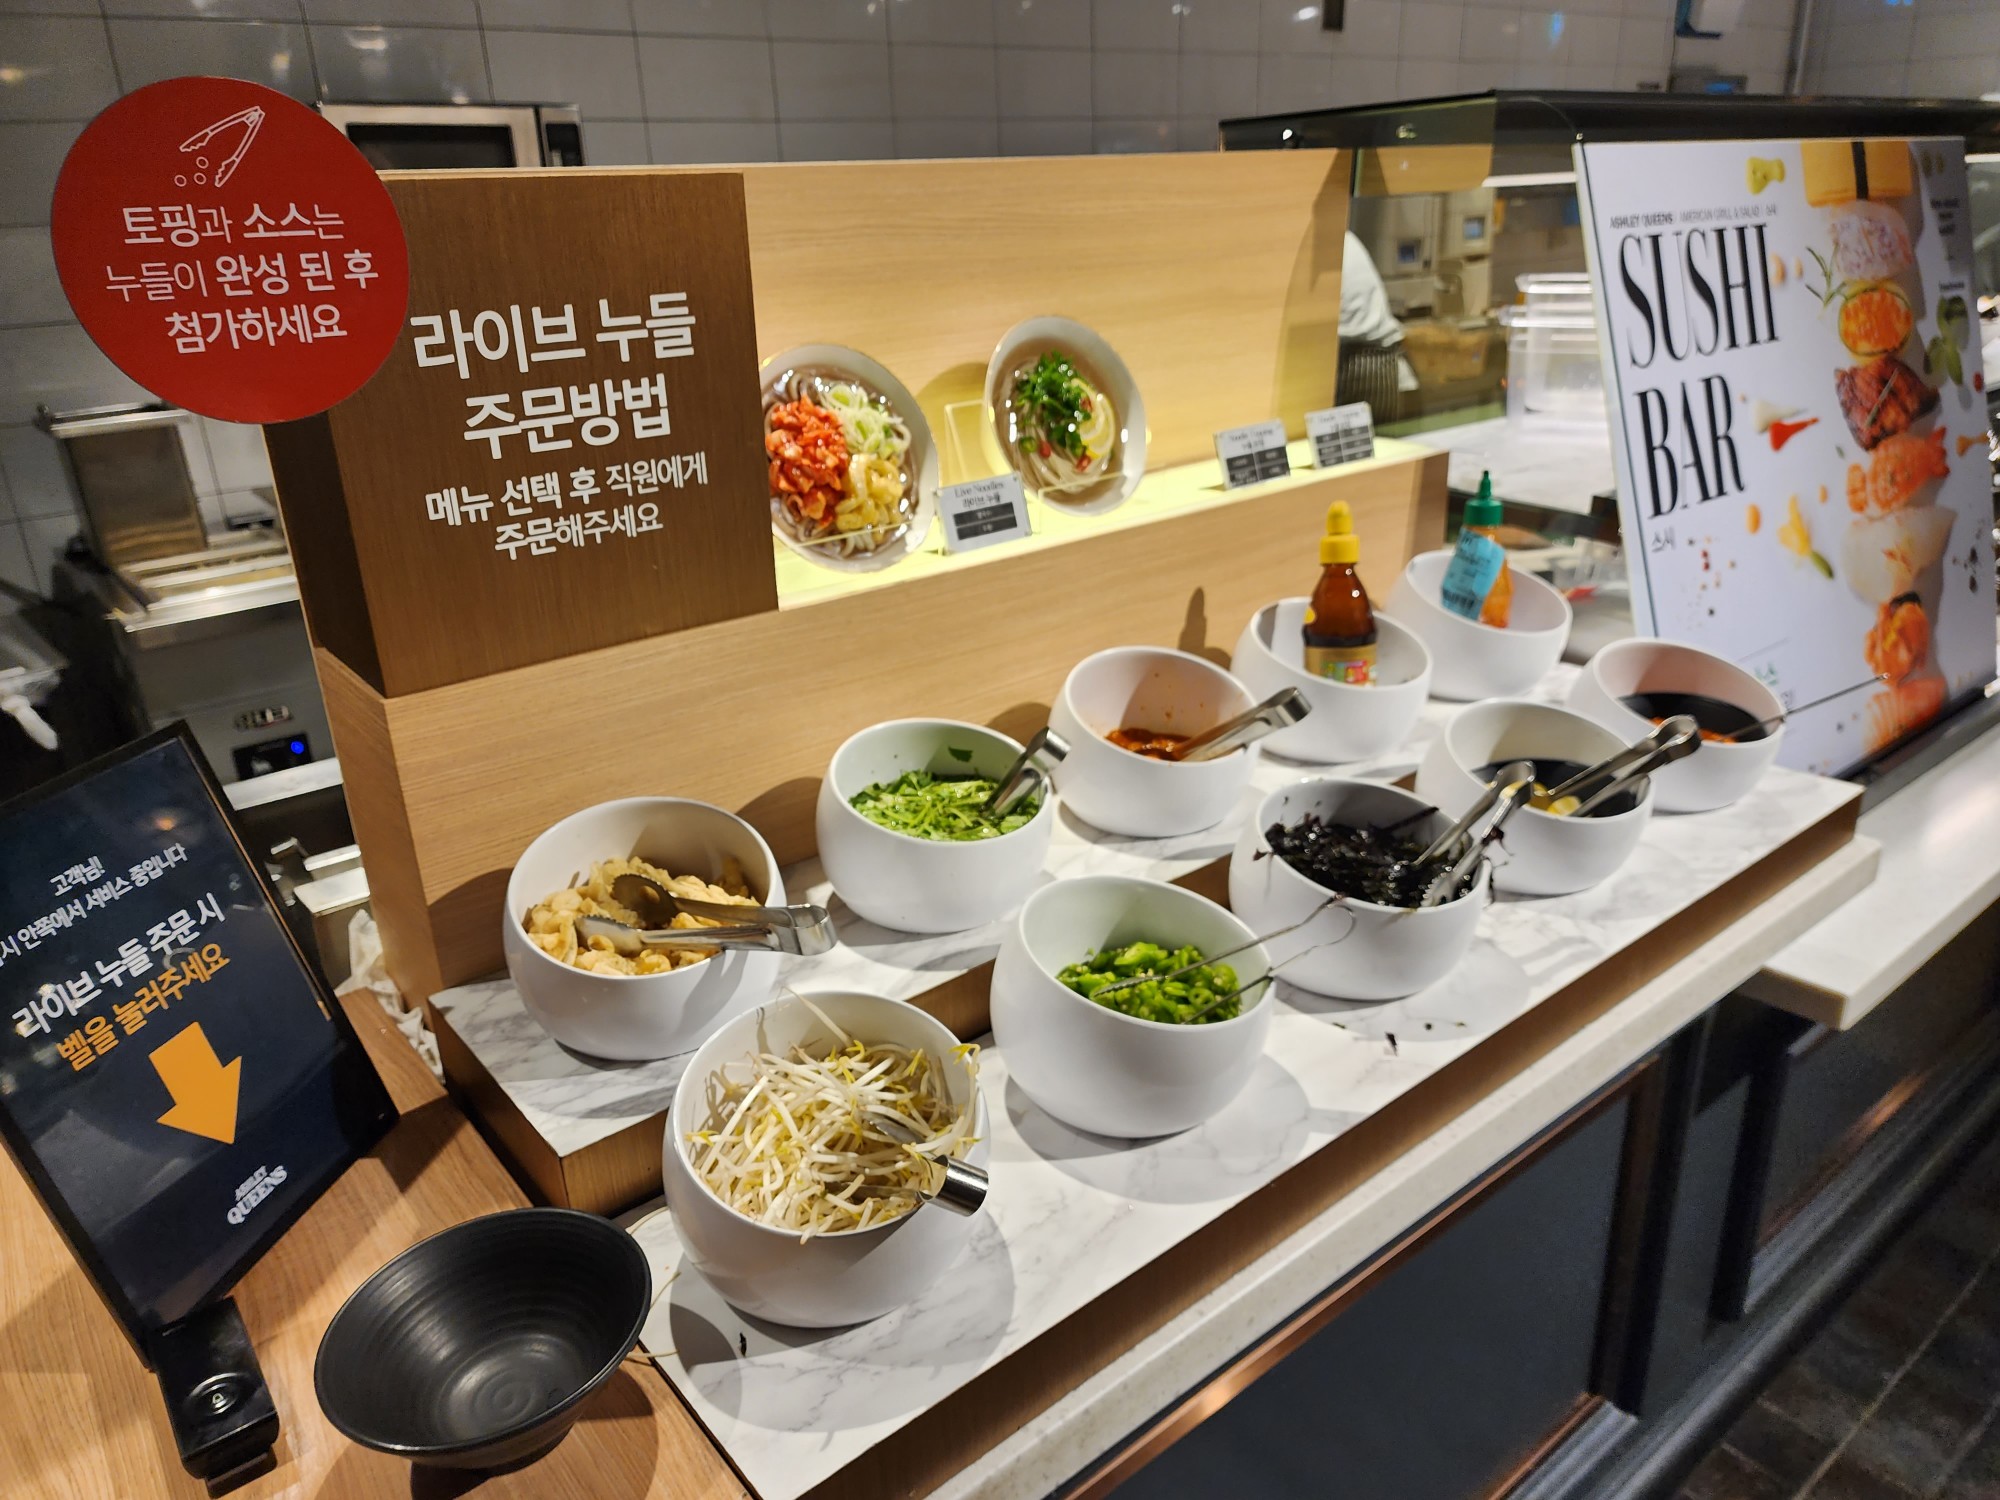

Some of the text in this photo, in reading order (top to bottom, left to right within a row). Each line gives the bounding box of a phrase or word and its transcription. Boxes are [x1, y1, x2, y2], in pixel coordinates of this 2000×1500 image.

[123, 203, 344, 247] 토핑과 소스는
[106, 249, 379, 302] 누들이 완성 된 후
[1619, 222, 1779, 368] SUSHI
[164, 304, 348, 353] 첨가하세요
[410, 292, 696, 379] 라이브 누들
[464, 373, 671, 460] 주문방법
[1633, 373, 1747, 520] BAR
[425, 451, 708, 526] 메뉴 선택 후 직원에게
[494, 502, 663, 560] 주문해주세요
[0, 842, 188, 967] 시 안쪽에서 서비스 중입니다
[50, 855, 105, 896] 고객님!
[12, 892, 226, 1037] 라이브 누들 주문 시
[56, 943, 231, 1071] 벨을 눌러주세요
[227, 1165, 288, 1225] QUEENS
